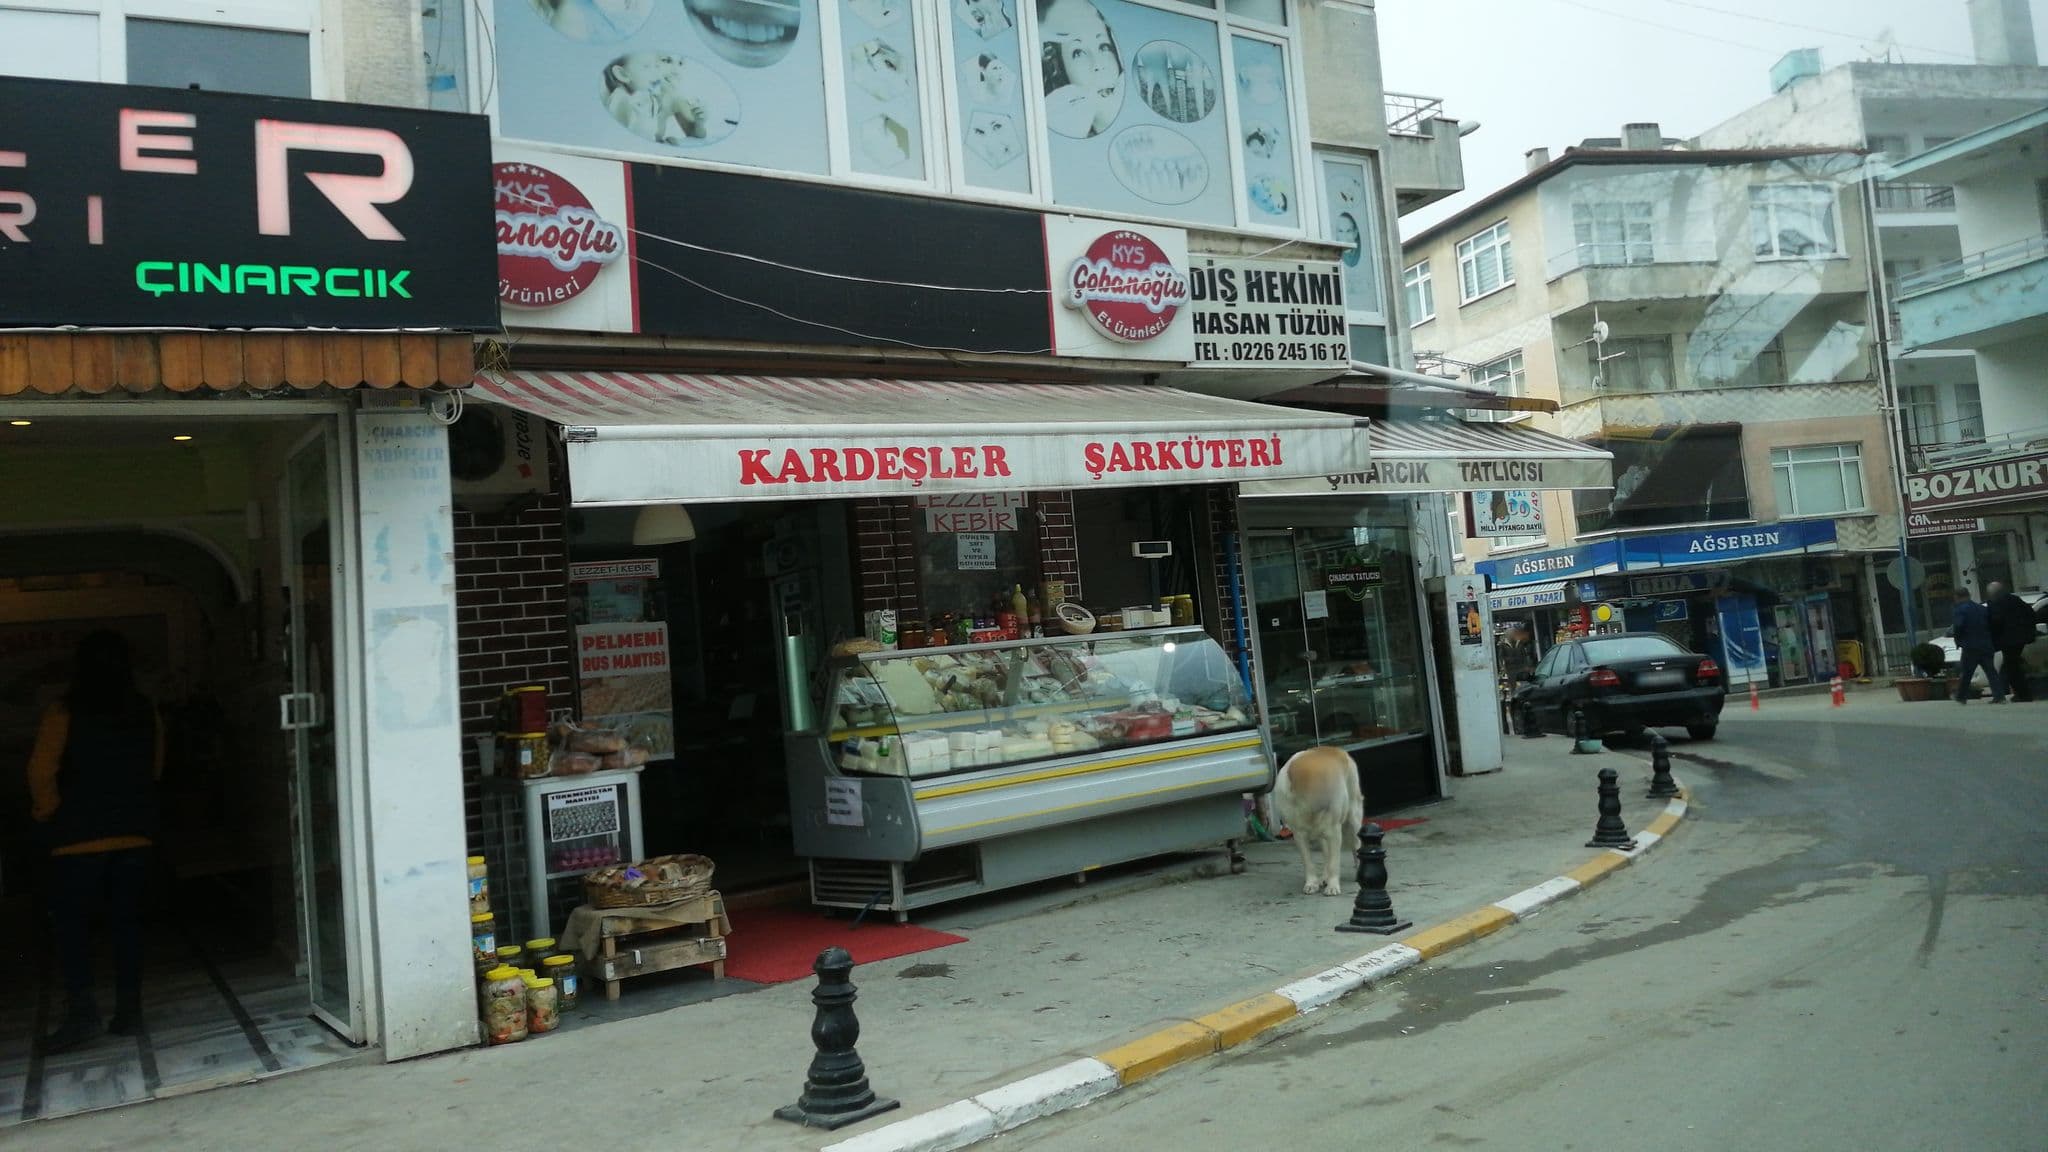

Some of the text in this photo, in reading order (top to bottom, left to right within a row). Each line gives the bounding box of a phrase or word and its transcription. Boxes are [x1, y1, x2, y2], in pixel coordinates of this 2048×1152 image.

[1111, 244, 1145, 264] KYS
[136, 261, 414, 298] ÇINARCIK
[1073, 264, 1186, 306] Çobanoğlu
[1190, 260, 1343, 307] DİŞ HEKİMİ
[1097, 311, 1165, 338] Et Ürünleri
[1193, 308, 1345, 336] HASAN TÜZÜN
[1232, 342, 1274, 361] 0226
[1278, 342, 1307, 361] 245
[1310, 343, 1327, 361] 16
[1330, 343, 1347, 361] 12
[737, 433, 1283, 487] KARDEŞLER ŞARKÜTERİ
[1457, 461, 1543, 482] TATLICISI
[933, 508, 1014, 532] KEBİR
[1688, 531, 1780, 554] AĞSEREN
[1513, 554, 1575, 576] AĞSEREN
[1507, 596, 1527, 607] GIDA
[1533, 591, 1563, 604] PAZARI
[582, 628, 664, 652] PELMENİ
[582, 655, 609, 672] RUS
